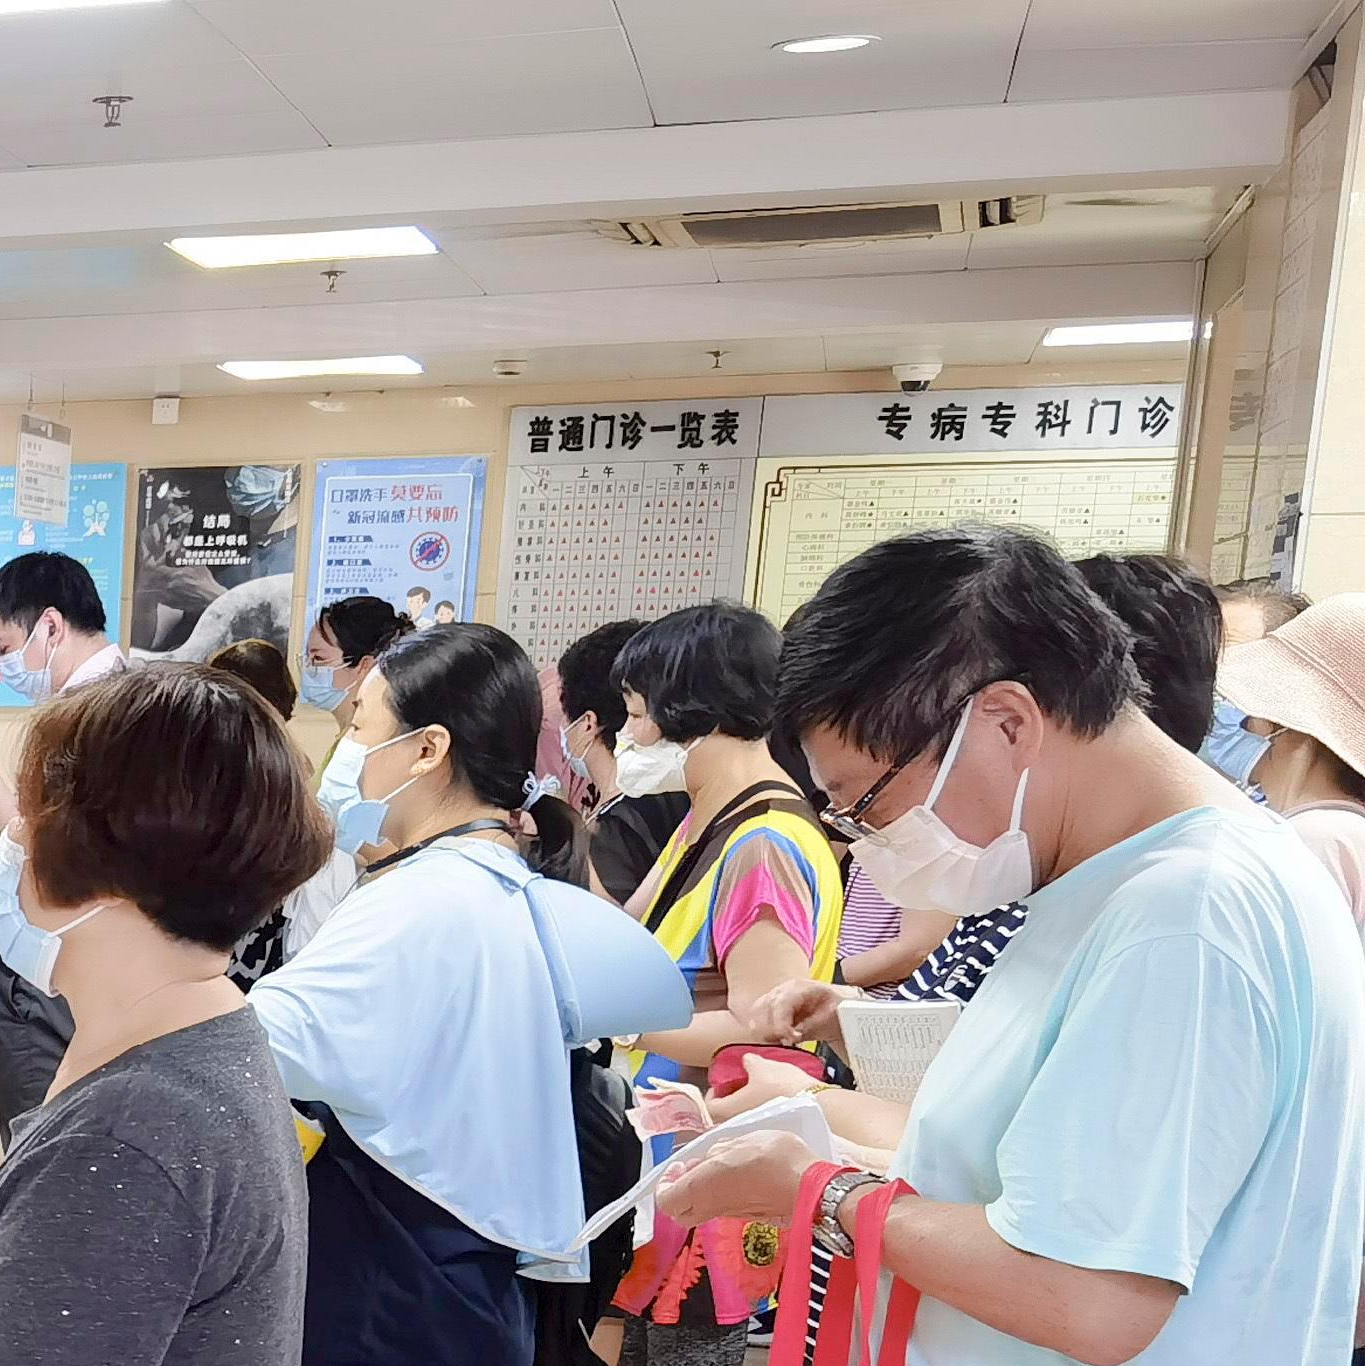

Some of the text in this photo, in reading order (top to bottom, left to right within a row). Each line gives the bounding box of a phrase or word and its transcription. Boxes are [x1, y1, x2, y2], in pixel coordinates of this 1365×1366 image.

[527, 409, 740, 453] 普通门诊一览表
[877, 397, 1177, 442] 专病专科门诊
